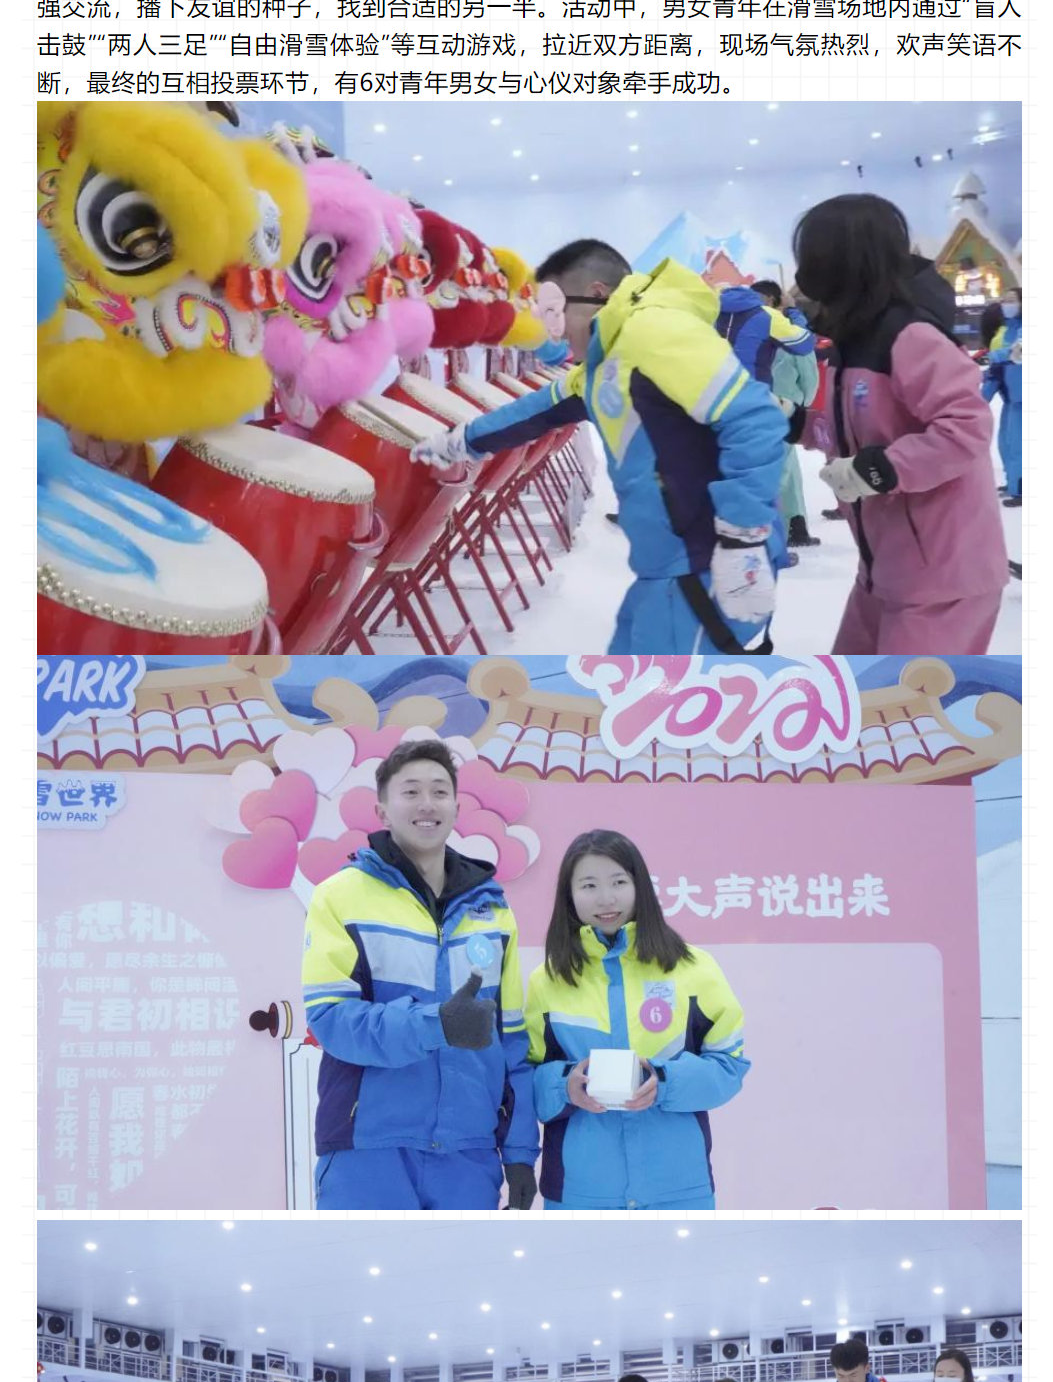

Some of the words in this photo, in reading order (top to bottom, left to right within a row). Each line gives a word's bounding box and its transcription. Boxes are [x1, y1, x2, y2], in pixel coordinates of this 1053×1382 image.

[66, 812, 98, 822] PARK
[652, 872, 891, 920] 大声说出来
[649, 1006, 662, 1024] 6
